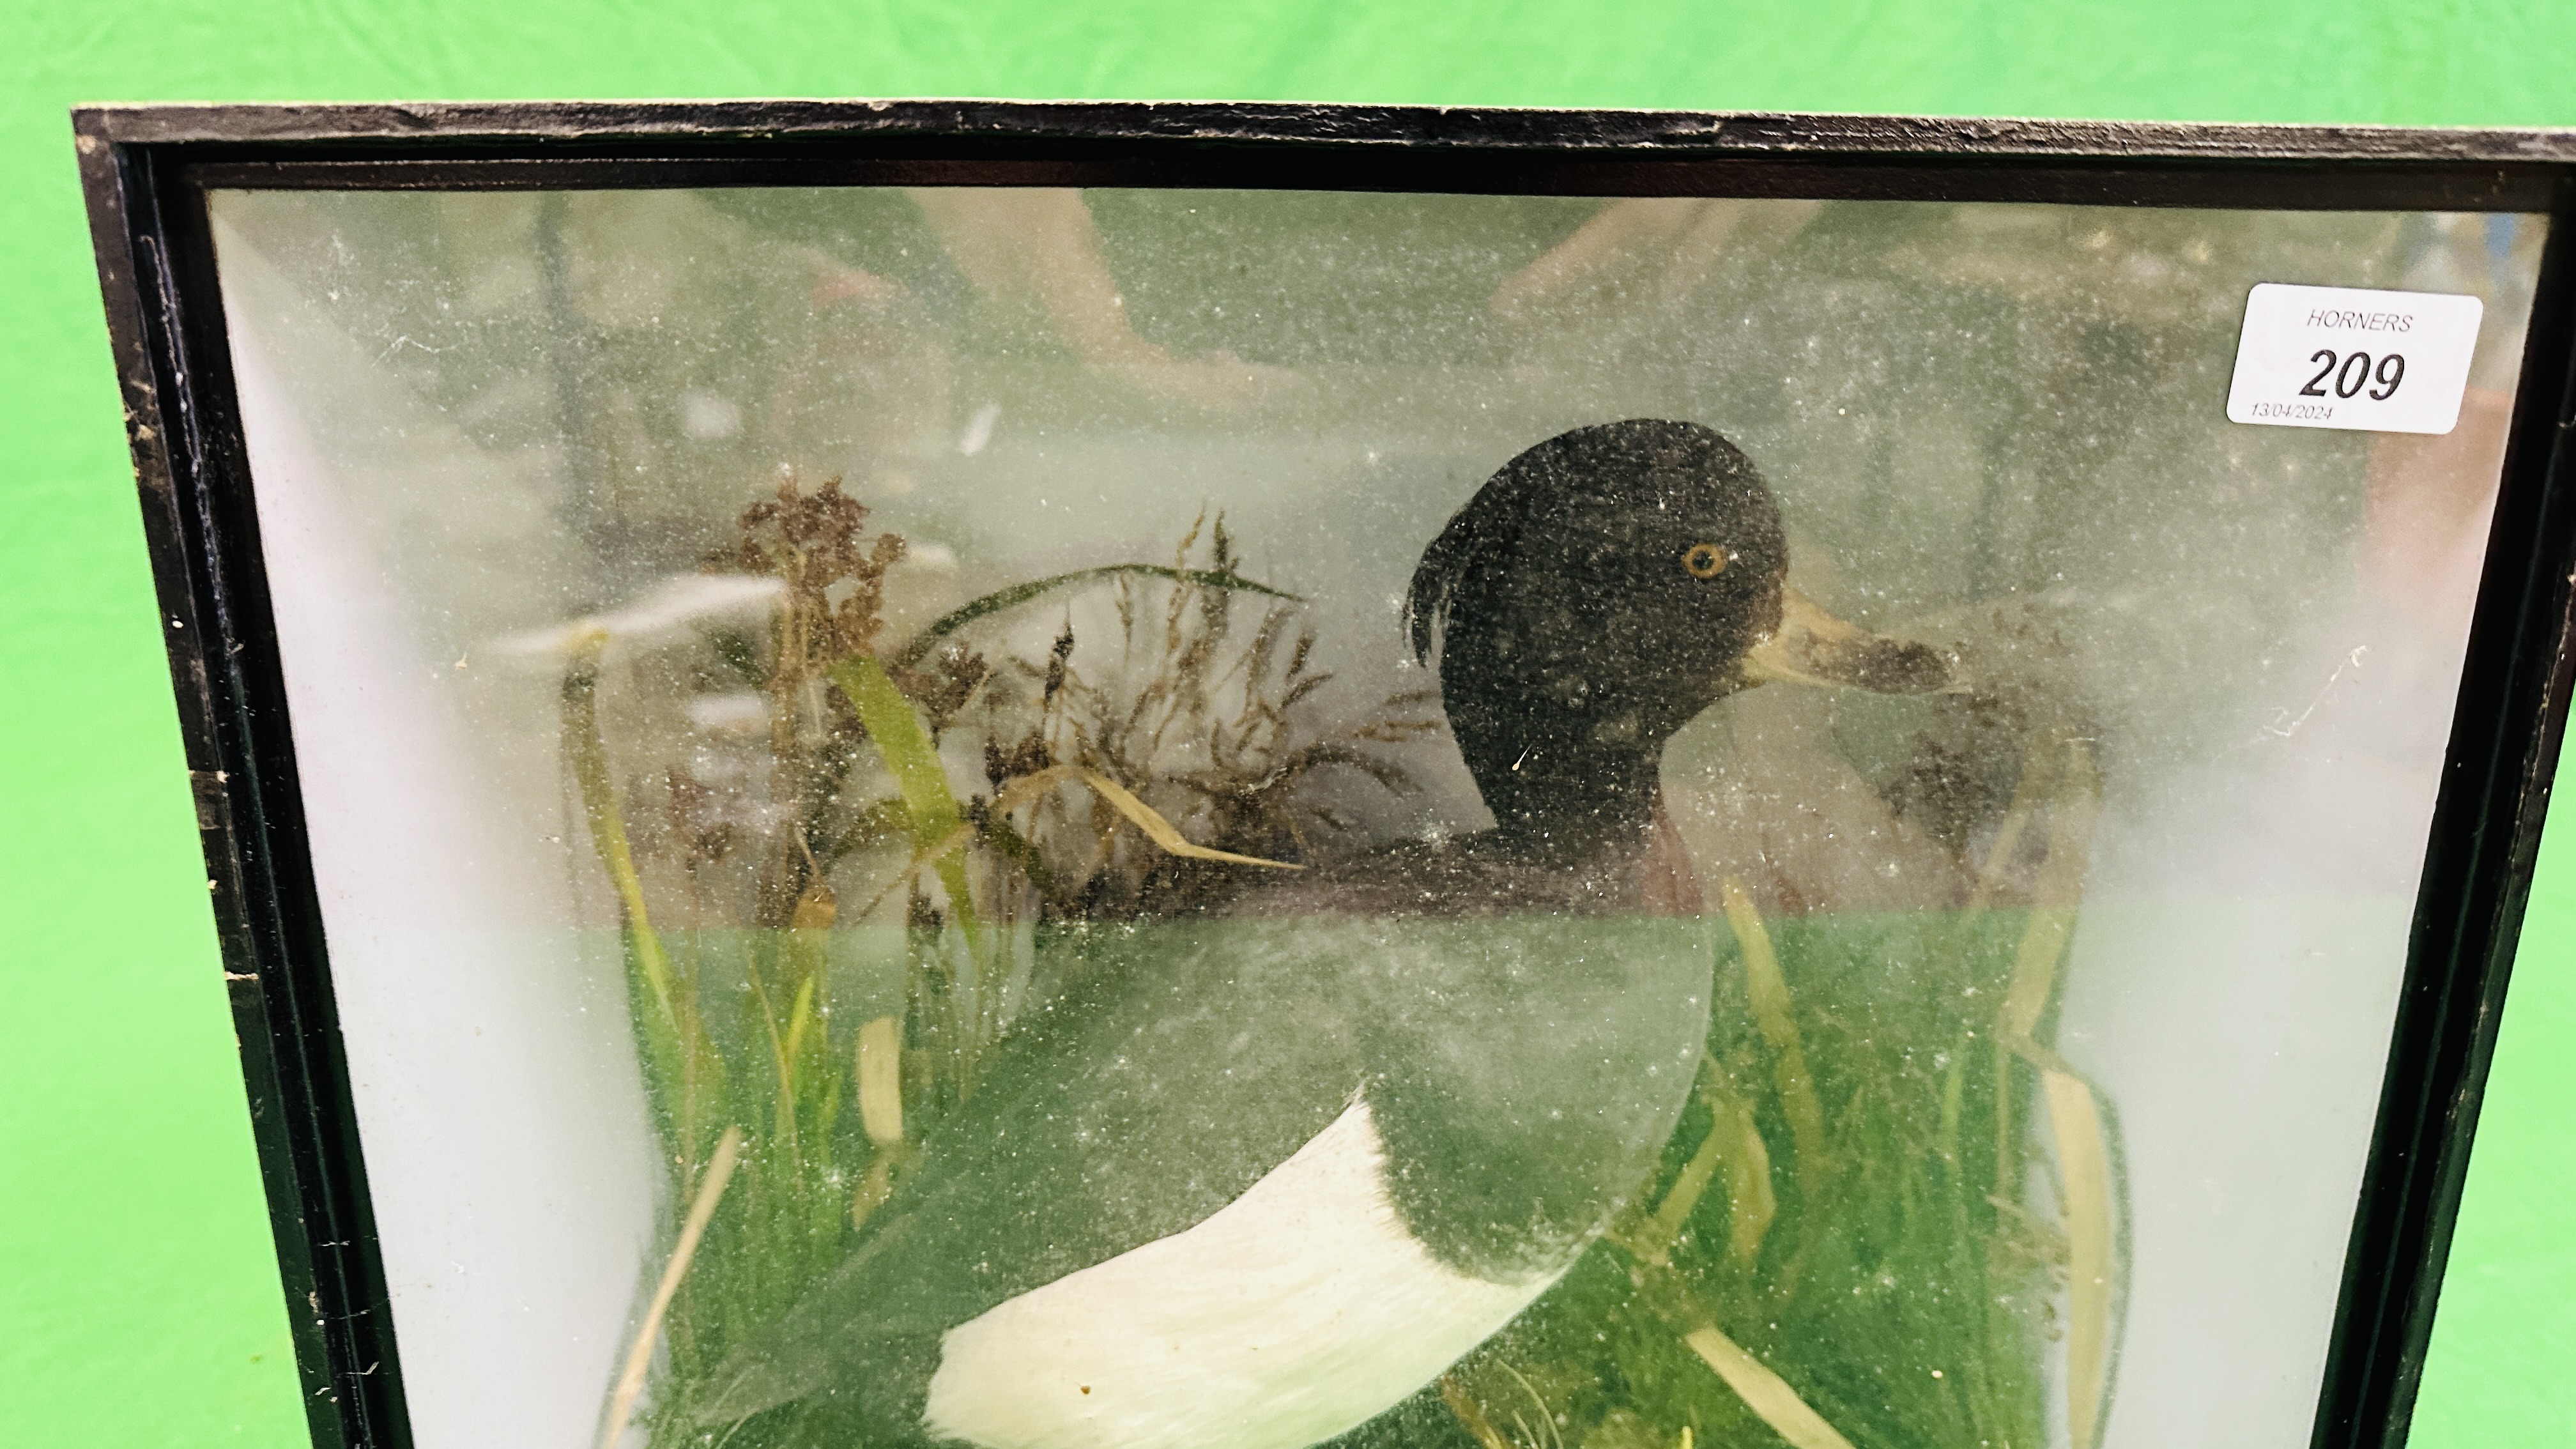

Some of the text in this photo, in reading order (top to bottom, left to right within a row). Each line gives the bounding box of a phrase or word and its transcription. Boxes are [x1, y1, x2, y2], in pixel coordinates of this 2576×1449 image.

[2306, 309, 2414, 332] HORNERS
[2298, 349, 2405, 401] 209
[2251, 402, 2333, 420] 13/04/2024
